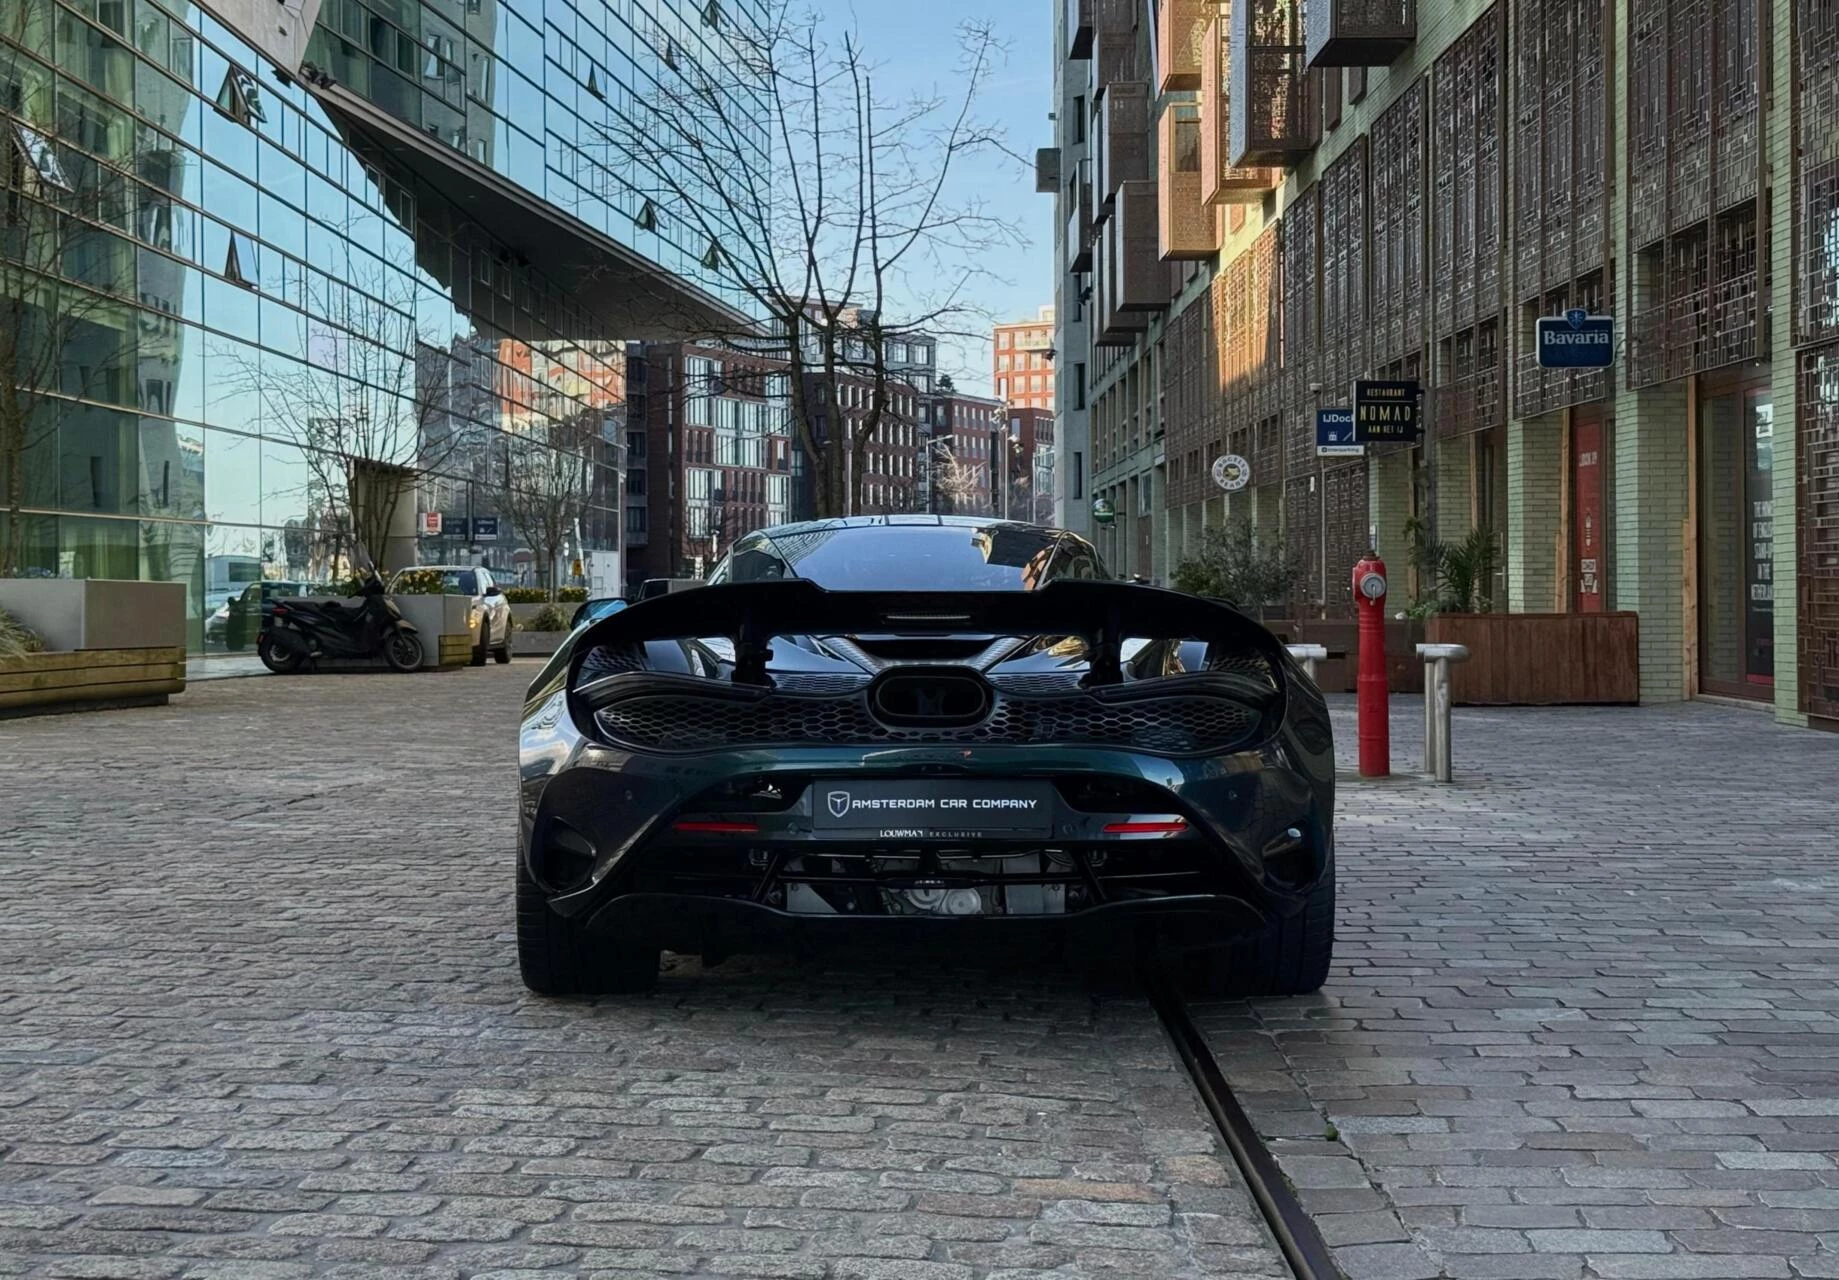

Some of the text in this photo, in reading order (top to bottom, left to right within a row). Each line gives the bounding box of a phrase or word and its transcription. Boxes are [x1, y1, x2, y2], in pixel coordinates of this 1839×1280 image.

[1543, 329, 1609, 345] Bavaria
[1367, 388, 1405, 397] RESTAURANT
[1360, 405, 1411, 421] NOMAD
[852, 799, 1037, 809] AMSTERDAM CAR COMPANY
